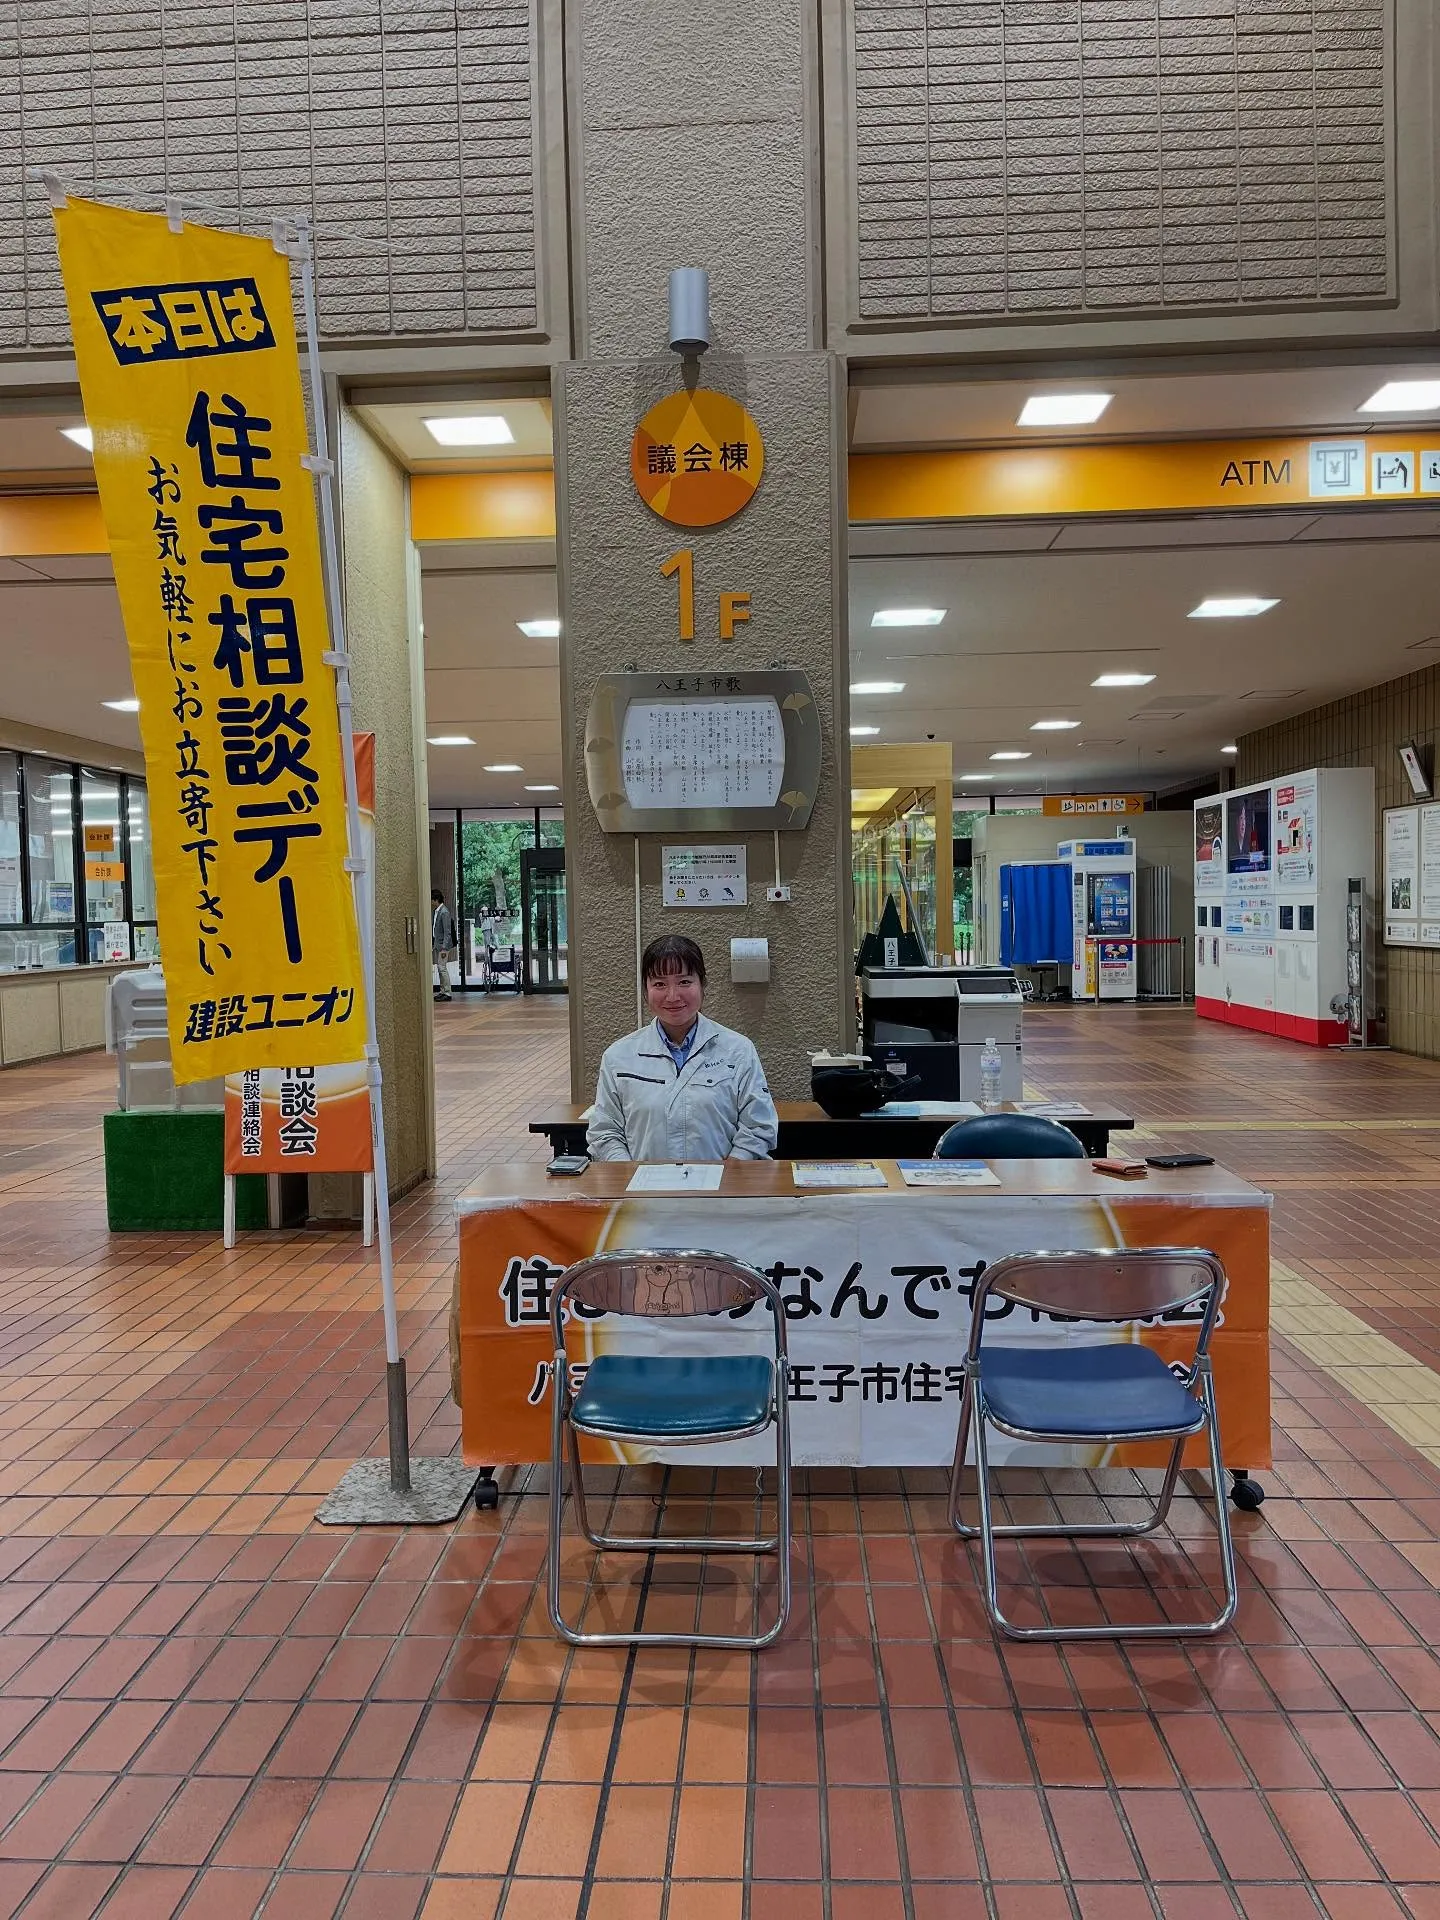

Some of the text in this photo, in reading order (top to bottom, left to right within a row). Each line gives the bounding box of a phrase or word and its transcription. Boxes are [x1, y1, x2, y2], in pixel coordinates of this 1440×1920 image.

[102, 287, 266, 355] 本日は
[647, 441, 749, 475] 議会棟
[1219, 458, 1291, 487] ATM
[659, 548, 752, 640] 1F
[186, 390, 323, 966] 住宅相談デー
[655, 676, 745, 693] 八王子市歌
[147, 455, 233, 977] お気軽にお立寄下さい
[887, 941, 896, 966] 八王子
[183, 986, 355, 1045] 建設ユニオン
